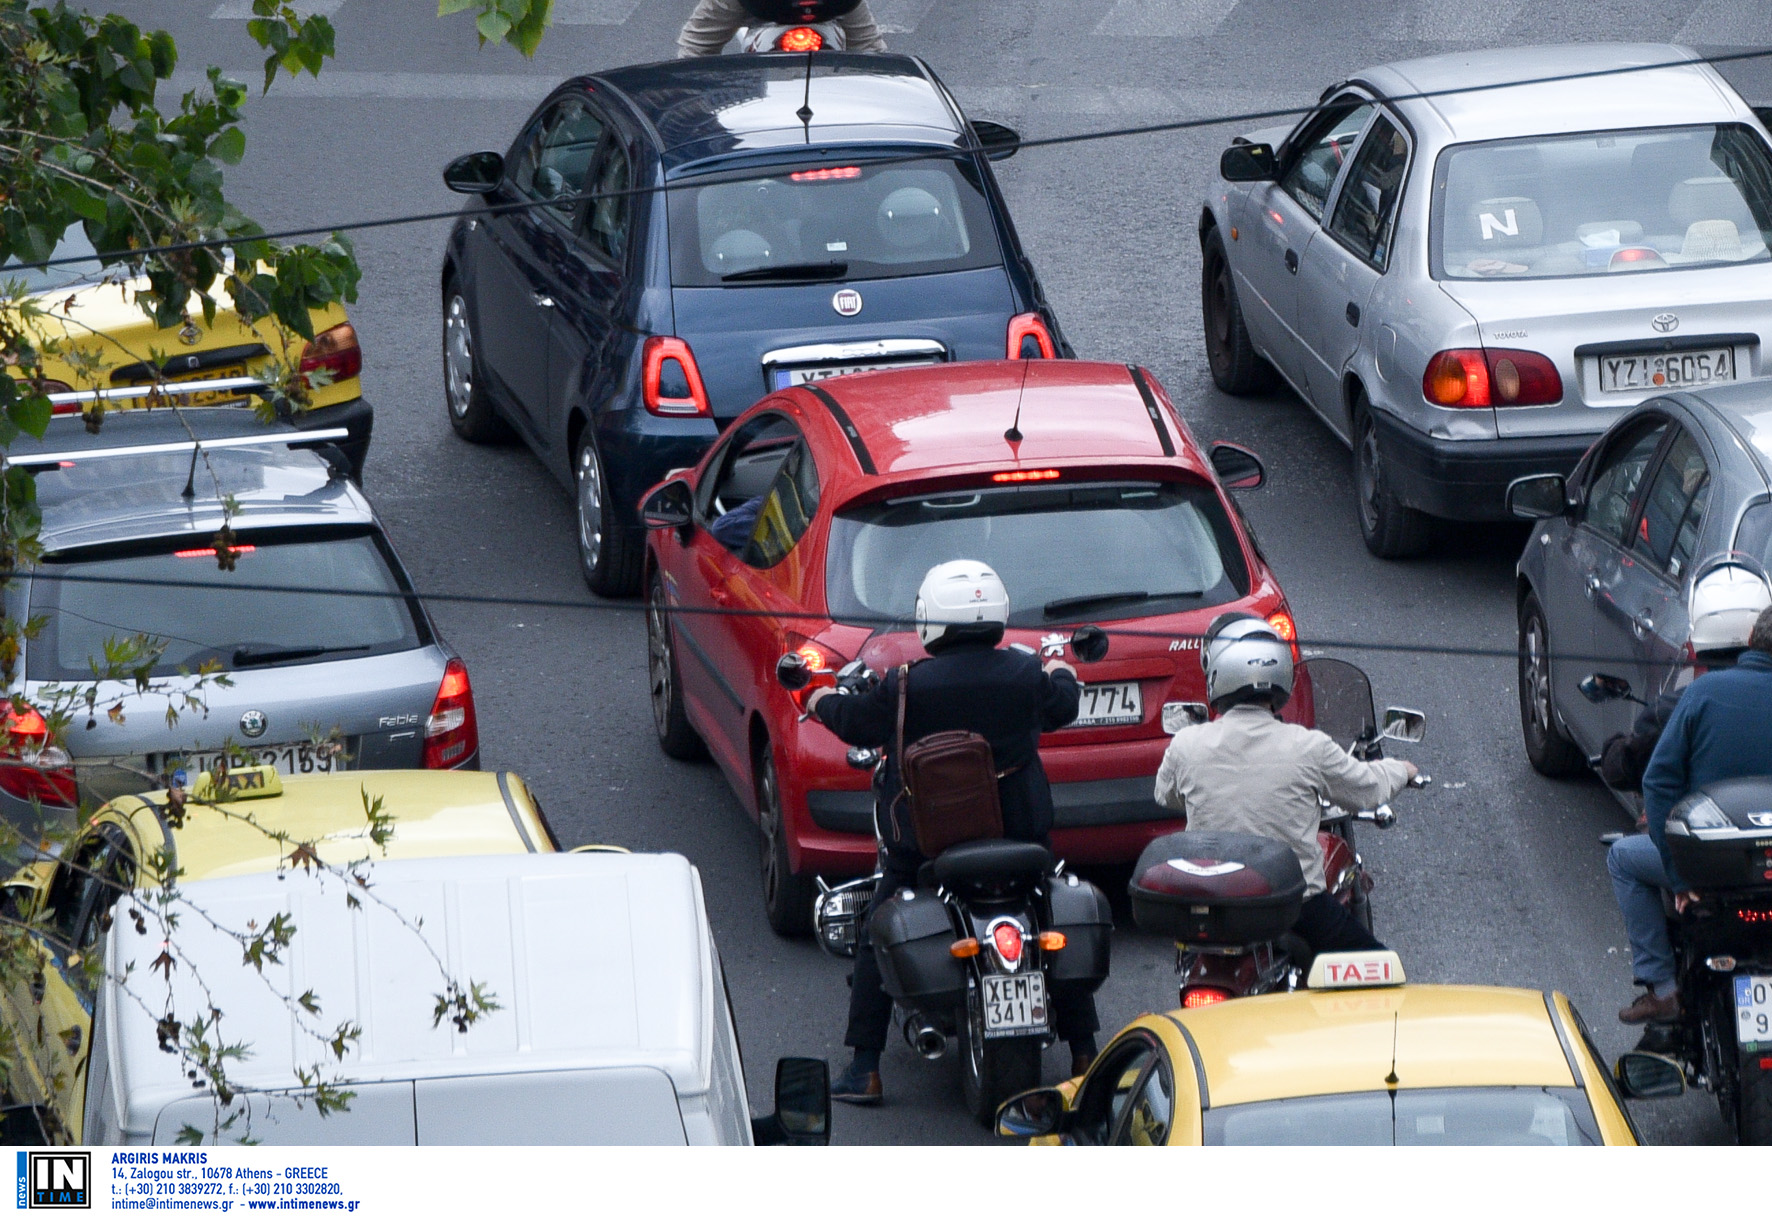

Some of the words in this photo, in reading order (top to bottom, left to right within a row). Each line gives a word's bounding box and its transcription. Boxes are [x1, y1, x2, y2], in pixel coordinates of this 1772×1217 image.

[1479, 208, 1519, 240] N
[1493, 330, 1528, 340] TOYOTA
[990, 979, 1028, 1002] XEM
[991, 1002, 1025, 1024] 341
